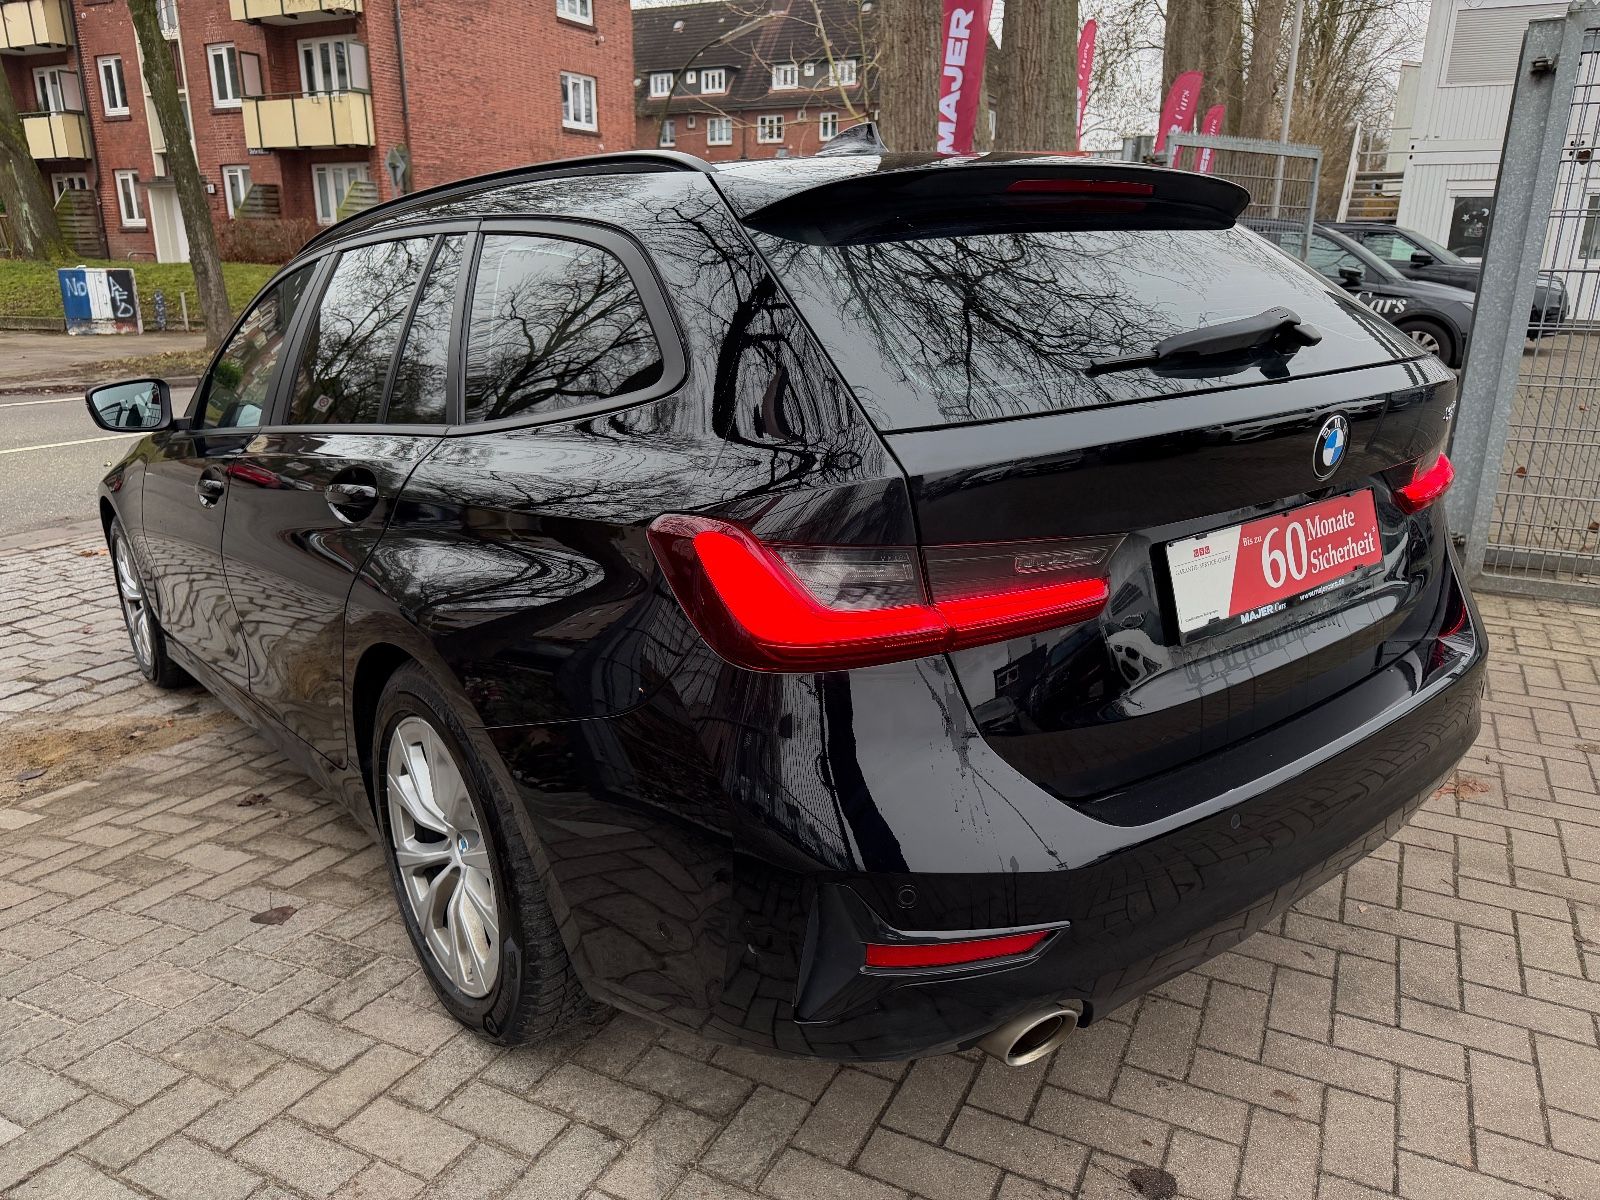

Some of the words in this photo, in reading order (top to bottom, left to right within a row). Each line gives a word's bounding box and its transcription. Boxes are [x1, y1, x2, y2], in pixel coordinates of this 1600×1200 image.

[936, 8, 974, 153] MAJER
[1306, 508, 1356, 542] Monate
[1242, 535, 1254, 547] Bis
[1253, 534, 1263, 544] zu
[1261, 521, 1308, 589] 60
[1240, 605, 1274, 625] MAJER
